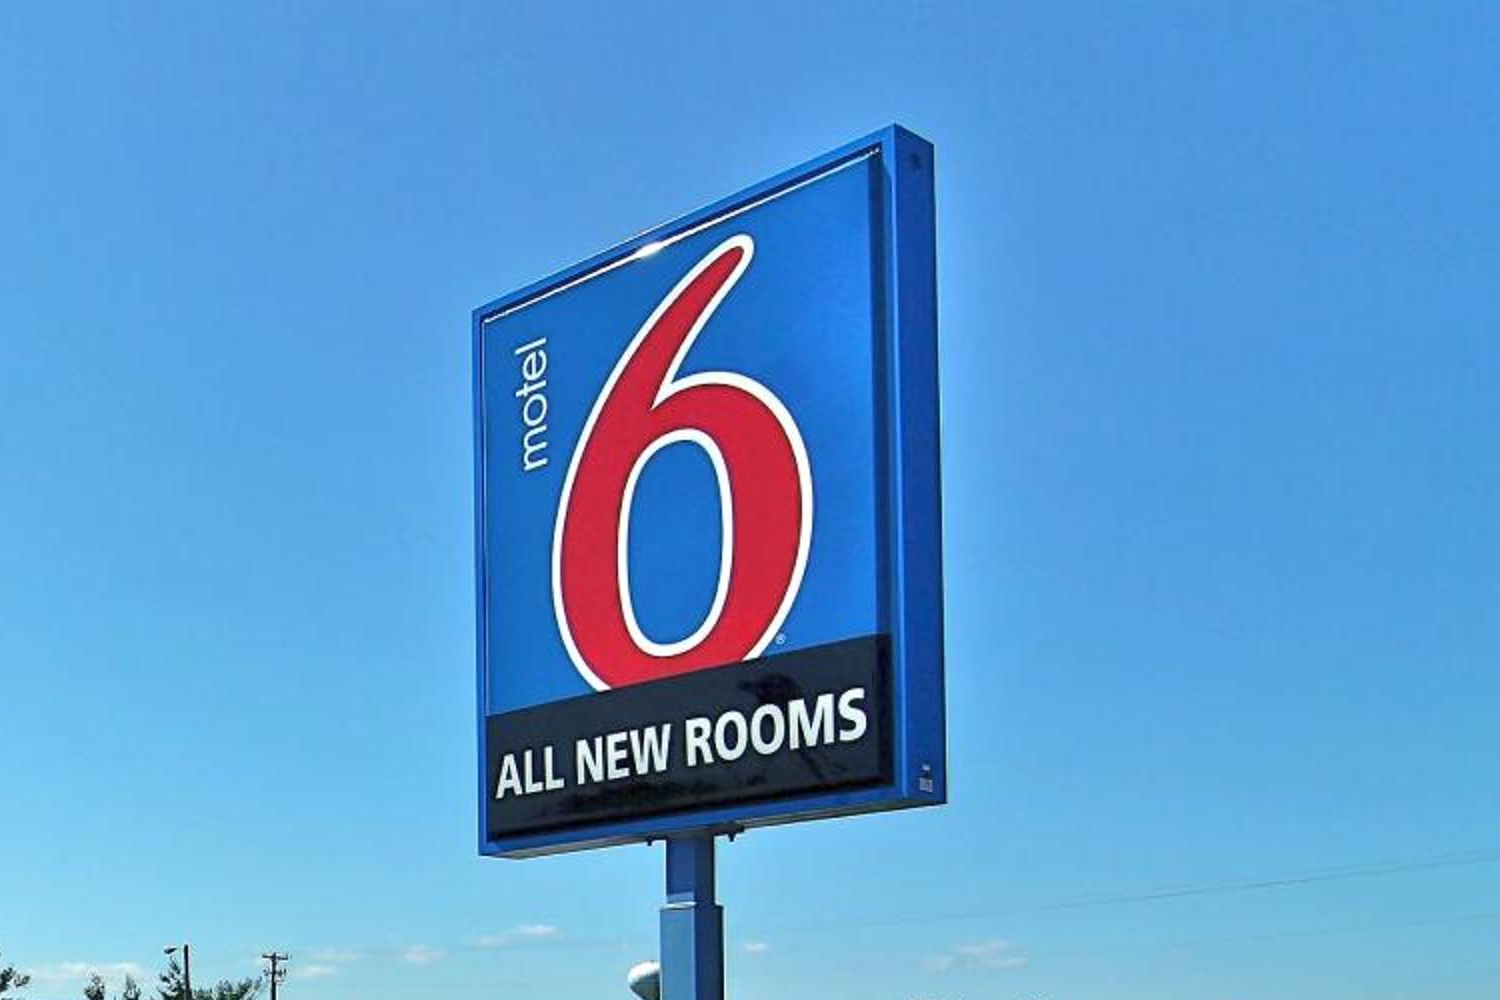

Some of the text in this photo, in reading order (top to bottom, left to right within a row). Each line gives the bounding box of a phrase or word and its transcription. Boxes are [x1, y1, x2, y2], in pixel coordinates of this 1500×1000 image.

[515, 337, 548, 472] motel
[551, 234, 813, 692] 6
[496, 687, 868, 799] ALL NEW ROOMS
